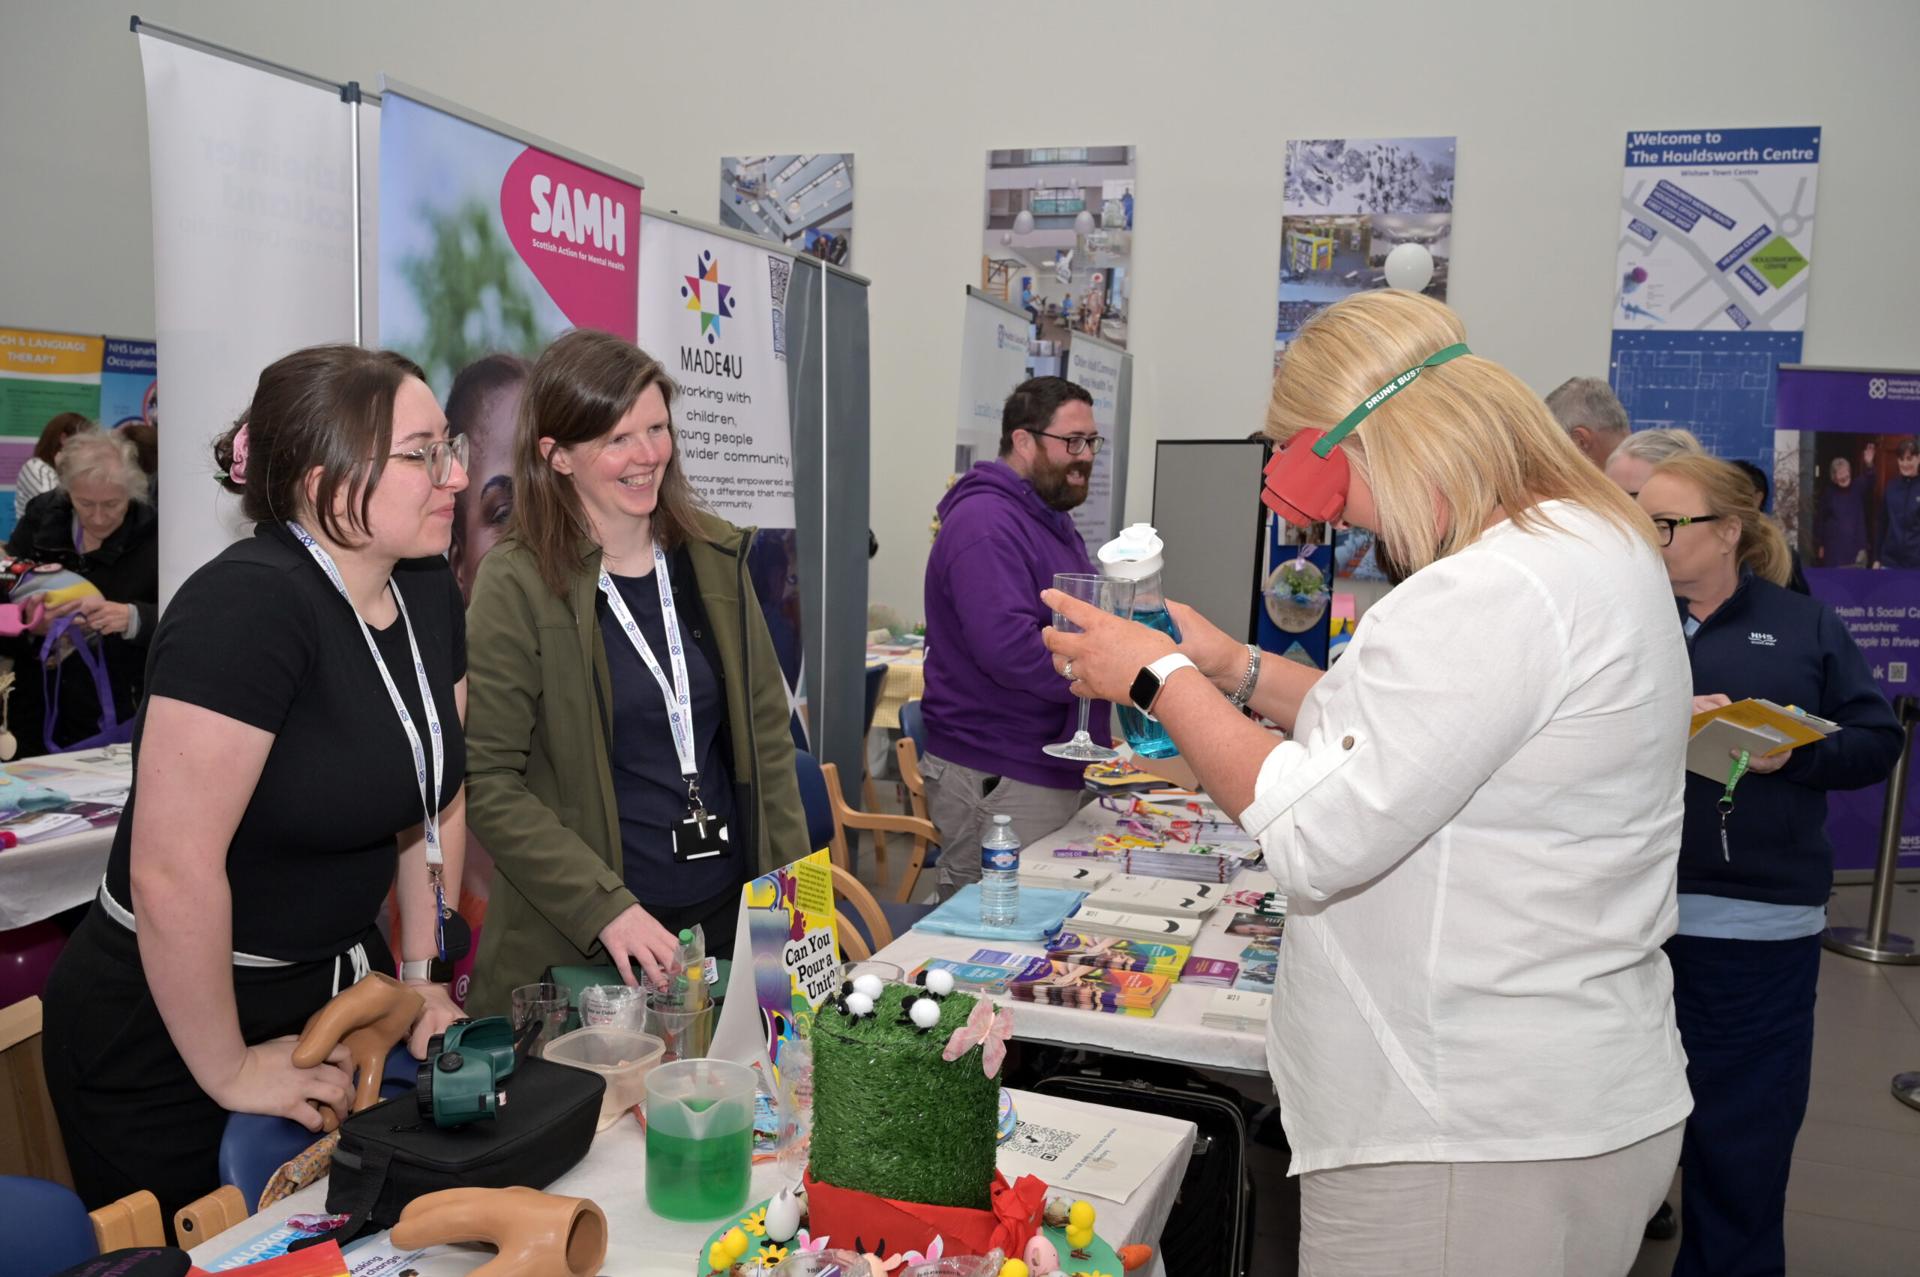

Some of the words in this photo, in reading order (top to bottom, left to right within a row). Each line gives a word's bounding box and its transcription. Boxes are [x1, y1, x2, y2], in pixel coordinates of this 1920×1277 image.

[1632, 132, 1702, 146] Welcome
[1706, 133, 1721, 145] to
[1631, 151, 1659, 164] The
[1662, 148, 1759, 163] Houldsworth
[1763, 148, 1814, 161] Centre
[530, 174, 625, 256] SAMH
[532, 239, 557, 253] Scottish
[558, 246, 577, 258] Action
[579, 251, 588, 261] for
[587, 254, 607, 266] Mental
[608, 260, 625, 271] Health
[29, 336, 87, 352] LANGUAGE
[109, 343, 128, 355] NHS
[8, 352, 57, 365] THERAPY
[681, 345, 742, 379] MADE4U
[727, 391, 752, 404] with
[1365, 384, 1398, 409] DRUNK
[686, 410, 738, 428] children,
[714, 432, 753, 447] people
[685, 447, 719, 460] wider
[723, 451, 790, 468] community
[716, 487, 755, 497] difference
[757, 489, 775, 498] that
[1836, 607, 1866, 617] Health
[1867, 607, 1874, 617] &
[1877, 607, 1906, 617] Social
[1751, 632, 1774, 640] NHS
[1881, 637, 1890, 647] to
[786, 944, 809, 967] Can
[808, 933, 831, 954] You
[797, 959, 826, 984] Pour
[825, 953, 833, 967] a
[807, 971, 836, 1000] Unit?
[366, 1255, 401, 1276] change
